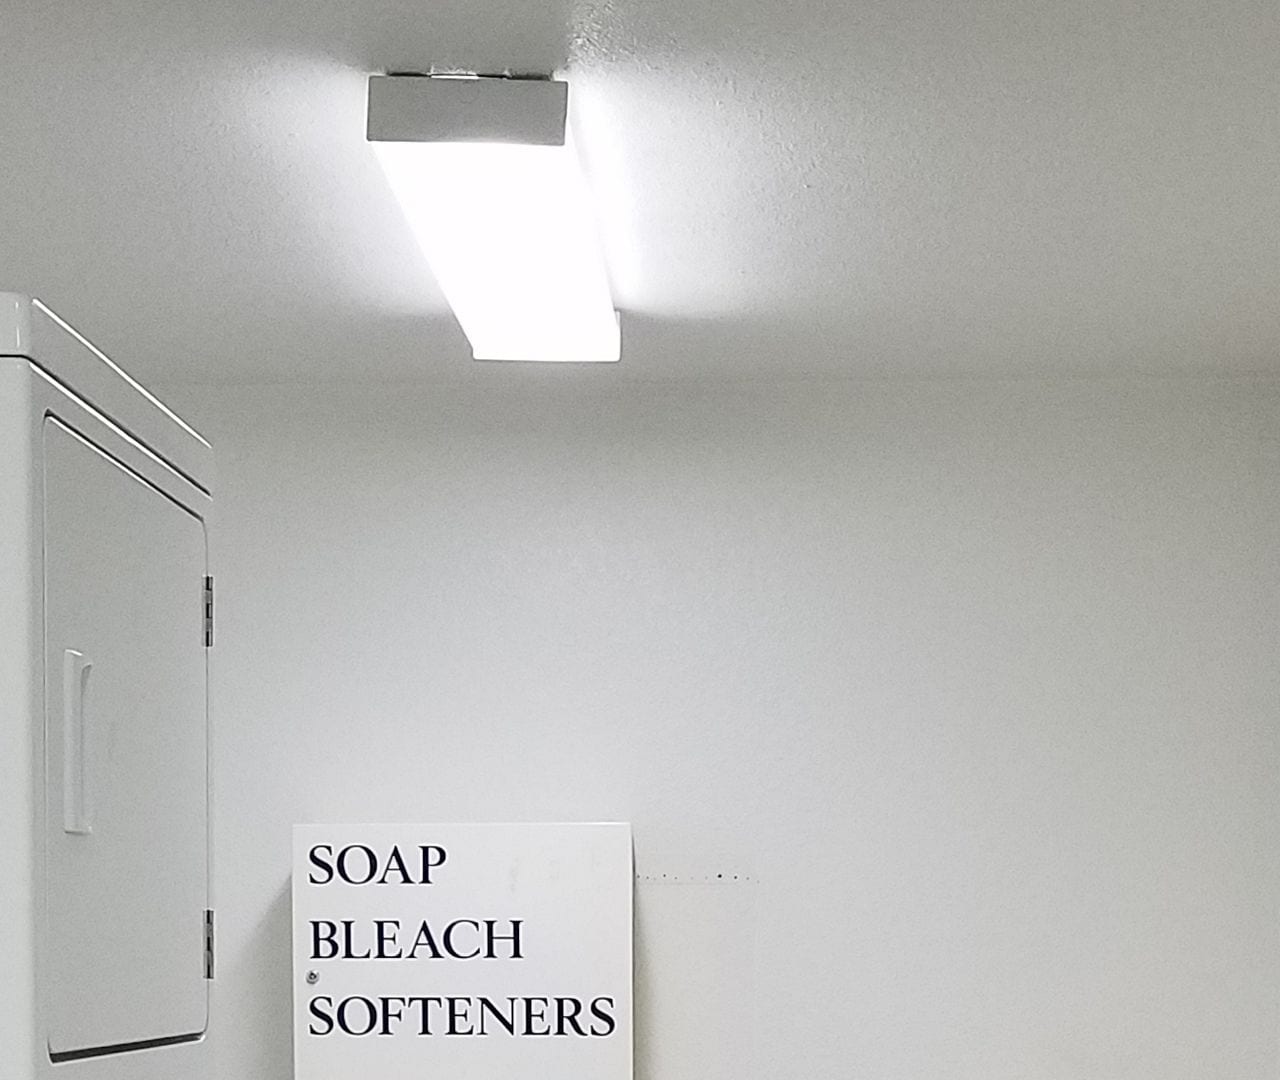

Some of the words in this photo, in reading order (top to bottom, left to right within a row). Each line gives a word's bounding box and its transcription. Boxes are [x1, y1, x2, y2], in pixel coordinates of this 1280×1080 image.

[308, 844, 447, 885] SOAP
[308, 918, 524, 960] BLEACH
[308, 995, 616, 1037] SOFTENERS
